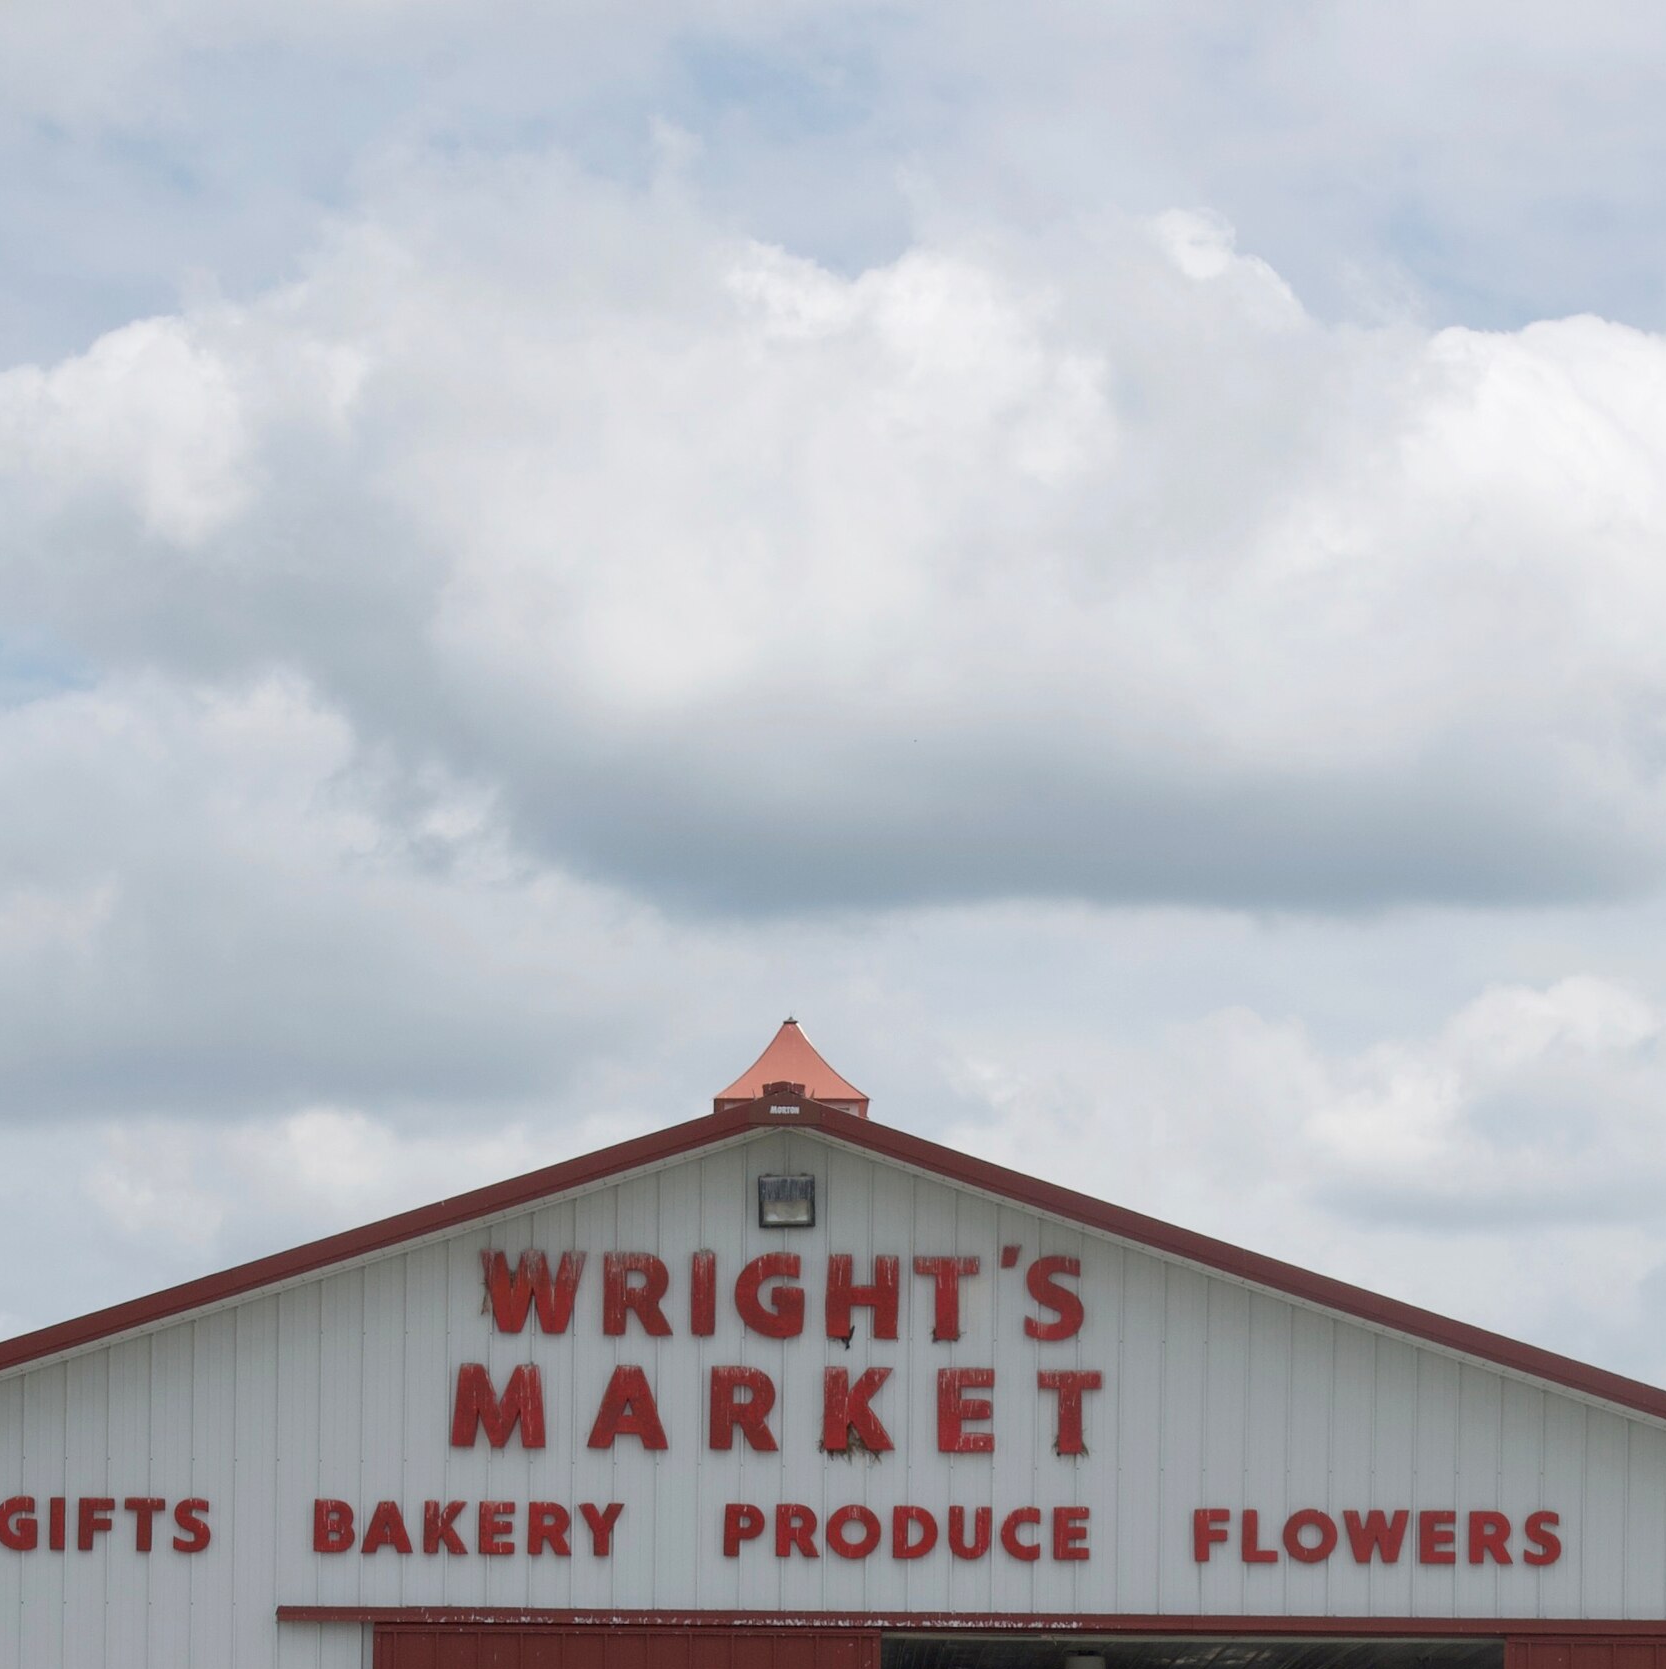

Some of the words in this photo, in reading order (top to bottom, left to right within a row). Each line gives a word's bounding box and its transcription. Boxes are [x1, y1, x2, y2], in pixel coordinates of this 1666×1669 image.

[483, 1246, 1085, 1342] WRIGHT'S
[450, 1363, 1103, 1454] MARKET
[313, 1499, 623, 1557] BAKERY
[723, 1503, 1091, 1562] PRODUCE
[1192, 1508, 1563, 1566] FLOWERS
